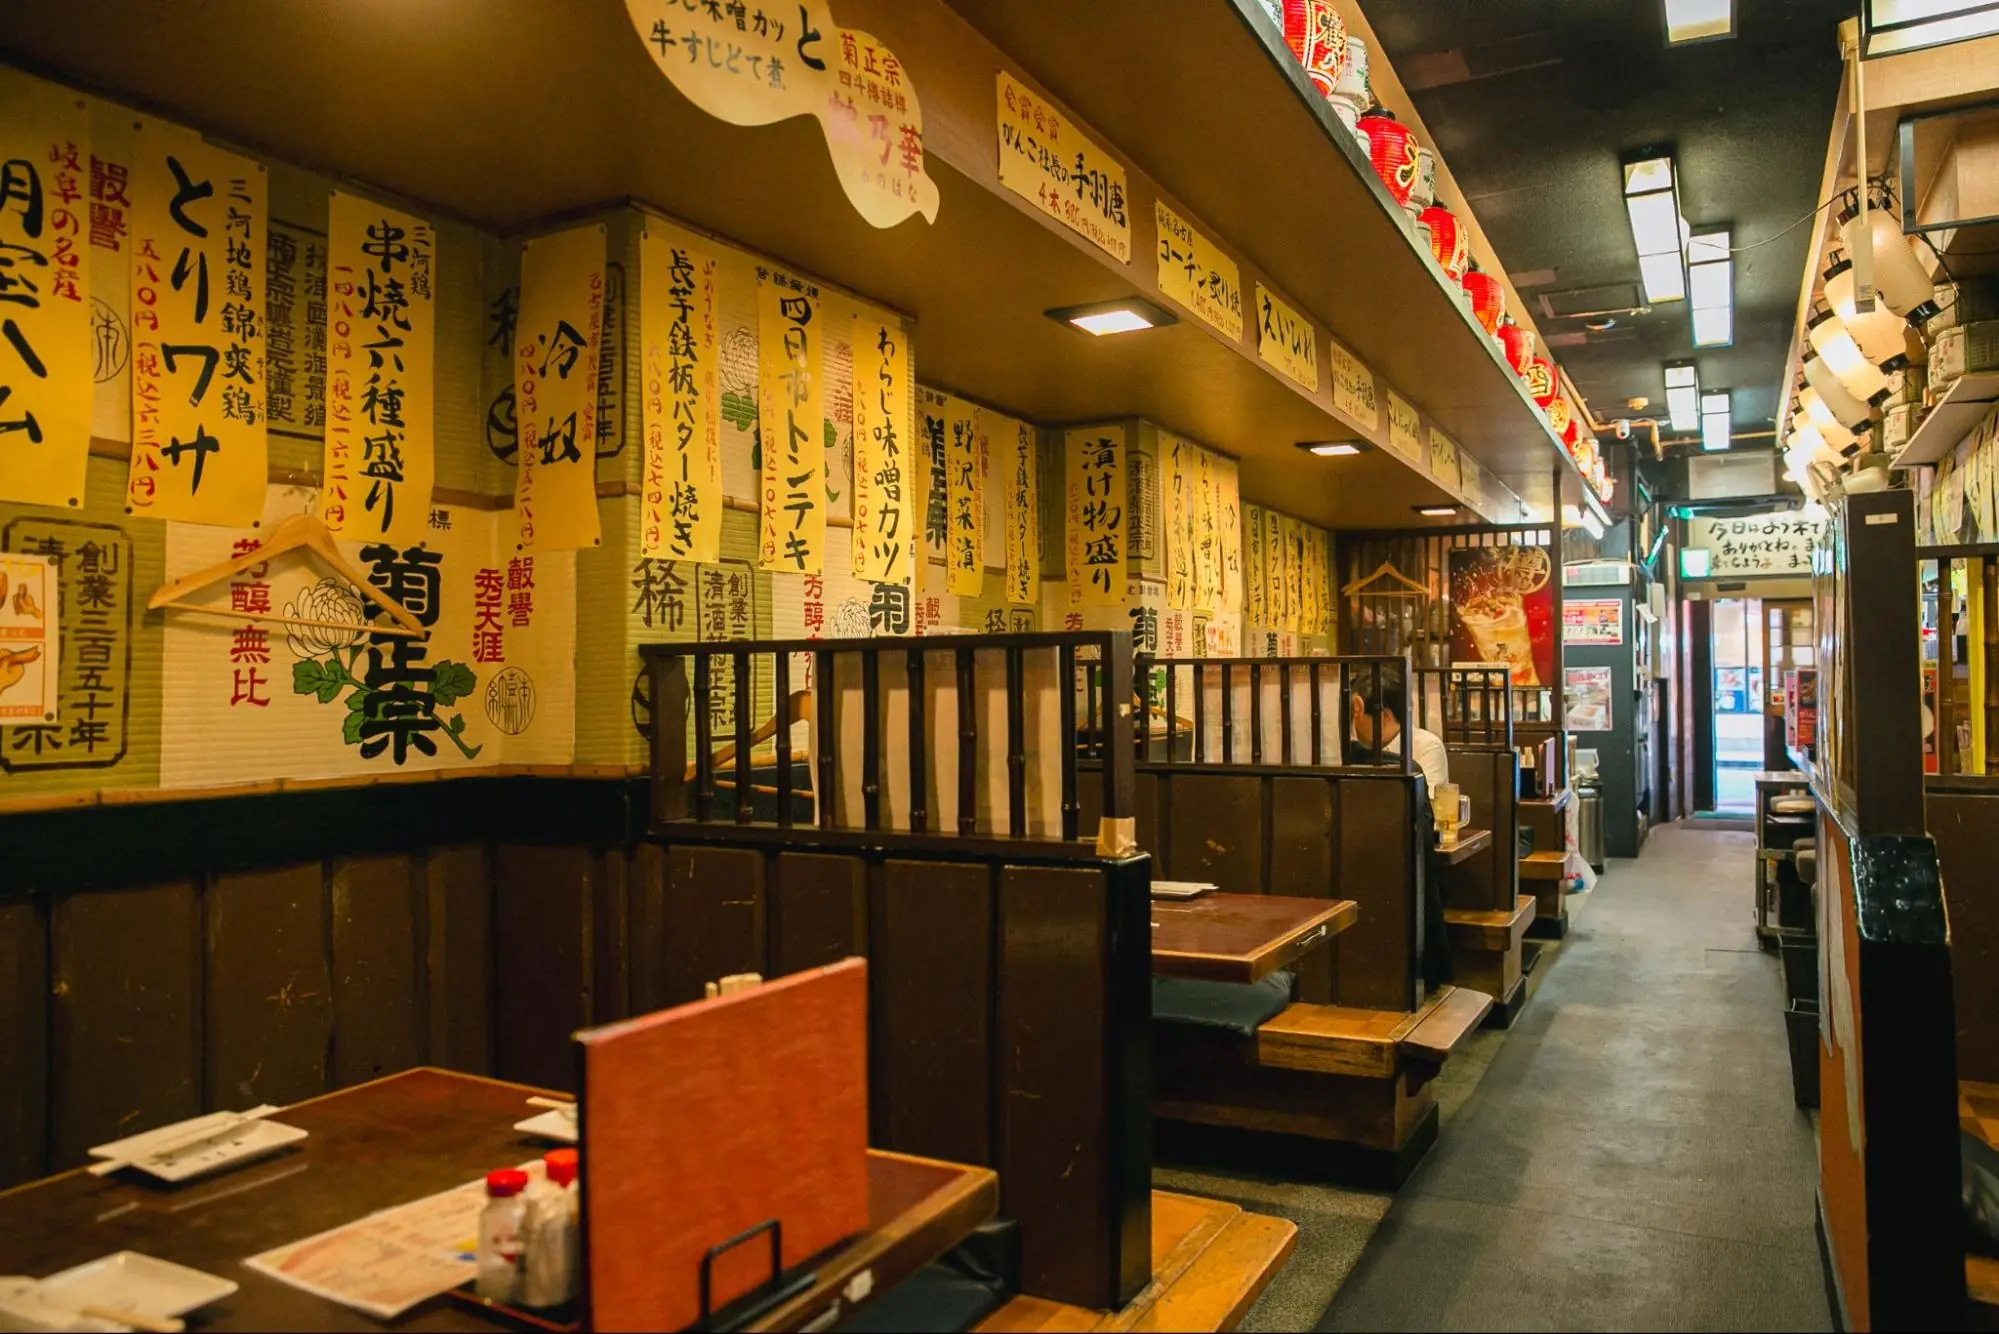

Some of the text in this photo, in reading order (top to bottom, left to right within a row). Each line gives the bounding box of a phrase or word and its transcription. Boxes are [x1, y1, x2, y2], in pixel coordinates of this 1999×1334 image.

[649, 18, 787, 91] 牛すじどて煮
[840, 31, 901, 86] 菊正宗
[48, 140, 82, 302] 岐阜の名産
[220, 179, 257, 425] 三河地鶏錦爽鶏
[409, 225, 432, 300] 三河鶏
[161, 155, 221, 496] とりワサ
[359, 219, 412, 533] 串焼六種盛り
[538, 320, 588, 466] 冷奴
[668, 249, 700, 556] 長芋鉄板バター焼き
[780, 297, 816, 570] 四日市トンテキ
[873, 327, 902, 577] わらじ味噌カツ
[953, 419, 976, 572] 野沢菜漬
[1082, 438, 1121, 593] 漬け物盛り
[69, 540, 118, 753] 創業三百五十年
[359, 544, 443, 766] 菊正宗
[473, 568, 506, 664] 秀天涯
